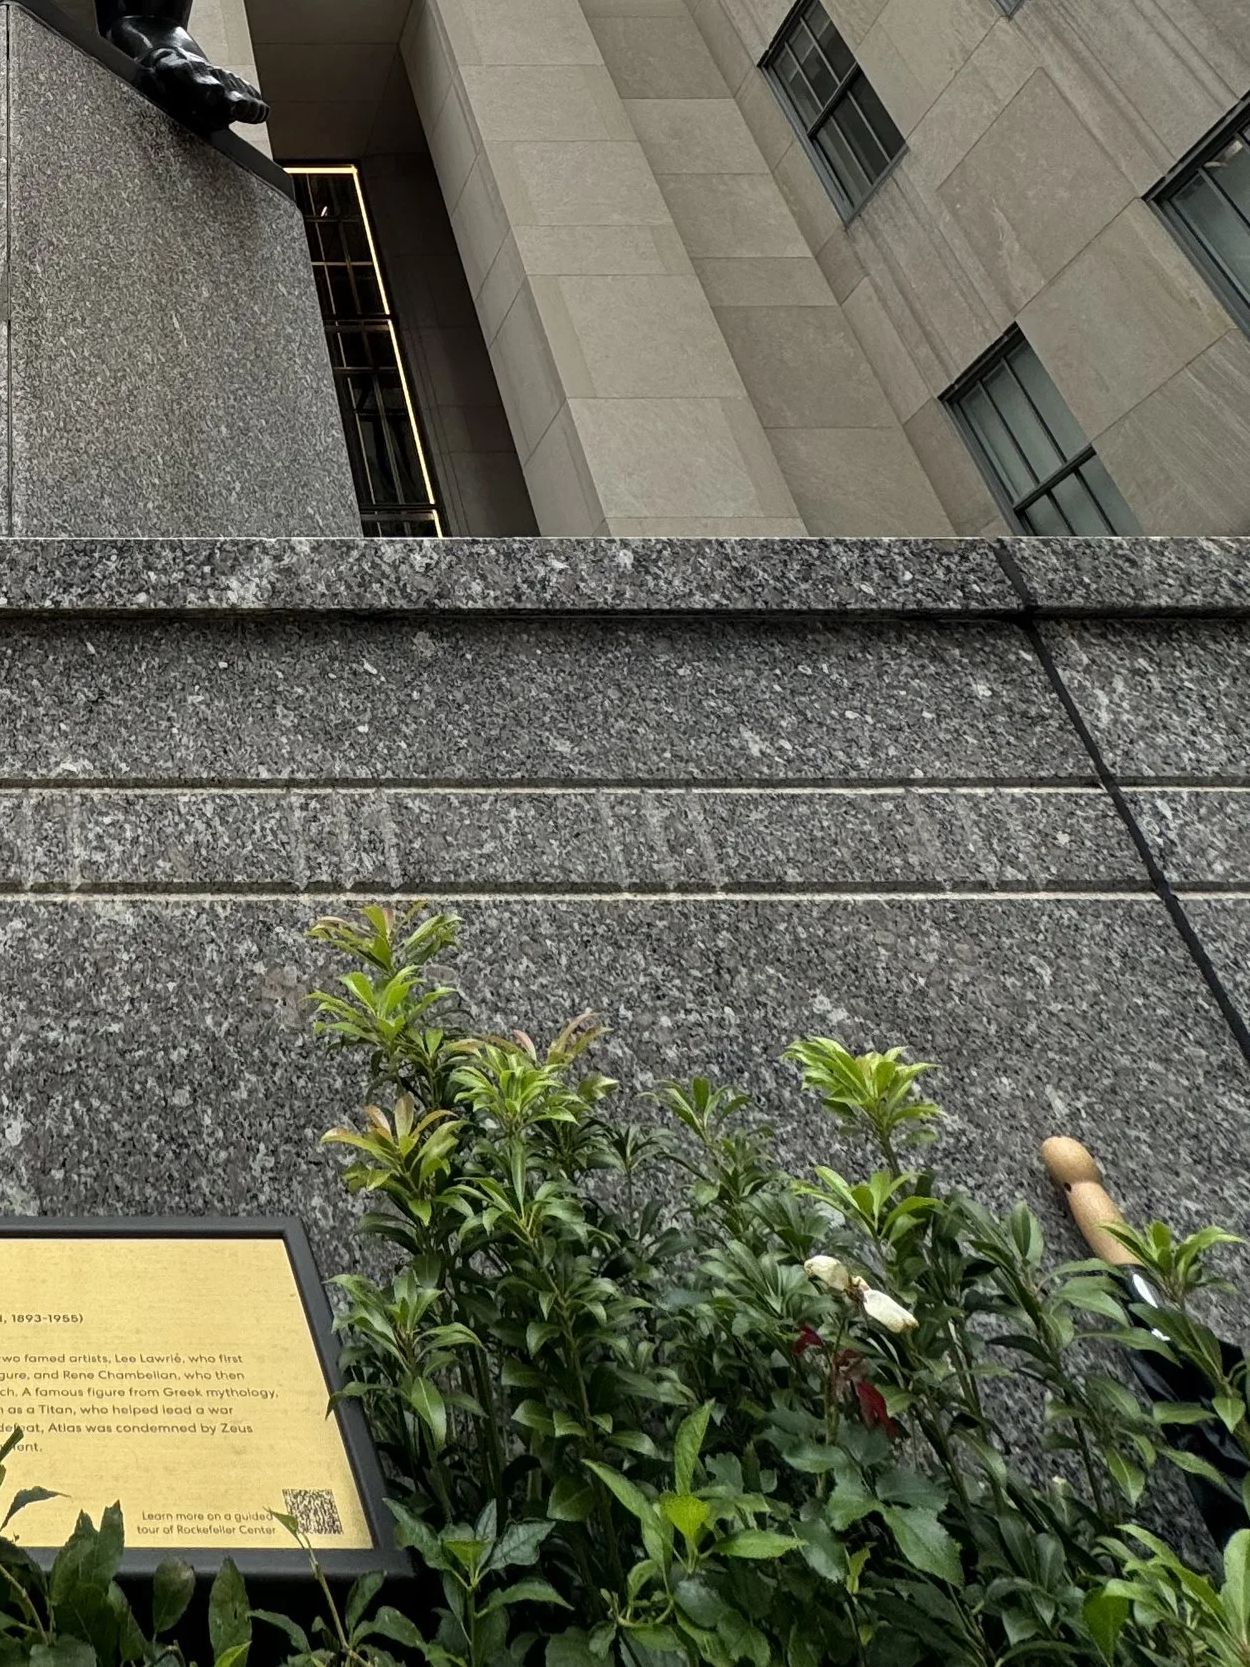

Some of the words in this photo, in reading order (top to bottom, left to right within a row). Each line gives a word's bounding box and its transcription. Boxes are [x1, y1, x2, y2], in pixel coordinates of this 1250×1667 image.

[11, 1313, 84, 1324] 1893-1955)
[24, 1353, 66, 1363] famed
[69, 1353, 112, 1364] artists,
[115, 1353, 137, 1363] Lee
[188, 1353, 216, 1363] who
[219, 1353, 243, 1363] first
[34, 1370, 60, 1380] and
[98, 1370, 181, 1381] Chambellan,
[184, 1370, 212, 1380] who
[215, 1370, 245, 1380] then
[21, 1386, 32, 1397] A
[35, 1386, 84, 1397] famous
[87, 1386, 126, 1400] figure
[129, 1386, 160, 1397] from
[163, 1386, 203, 1397] Greek
[7, 1406, 23, 1414] as
[26, 1406, 35, 1414] a
[38, 1404, 77, 1416] Titan,
[80, 1404, 109, 1415] who
[112, 1404, 159, 1417] helped
[162, 1404, 192, 1415] lead
[196, 1407, 205, 1415] a
[208, 1406, 234, 1415] war
[48, 1422, 82, 1433] Atlas
[85, 1424, 113, 1433] was
[116, 1422, 197, 1433] condemned
[200, 1422, 217, 1436] by
[220, 1422, 254, 1433] Zeus
[142, 1510, 173, 1521] Learn
[176, 1512, 204, 1521] more
[207, 1512, 221, 1521] on
[224, 1512, 232, 1521] a
[234, 1511, 274, 1523] guided
[137, 1524, 160, 1535] tour
[163, 1524, 174, 1535] of
[177, 1524, 236, 1535] Rockefeller
[239, 1524, 276, 1535] Center
